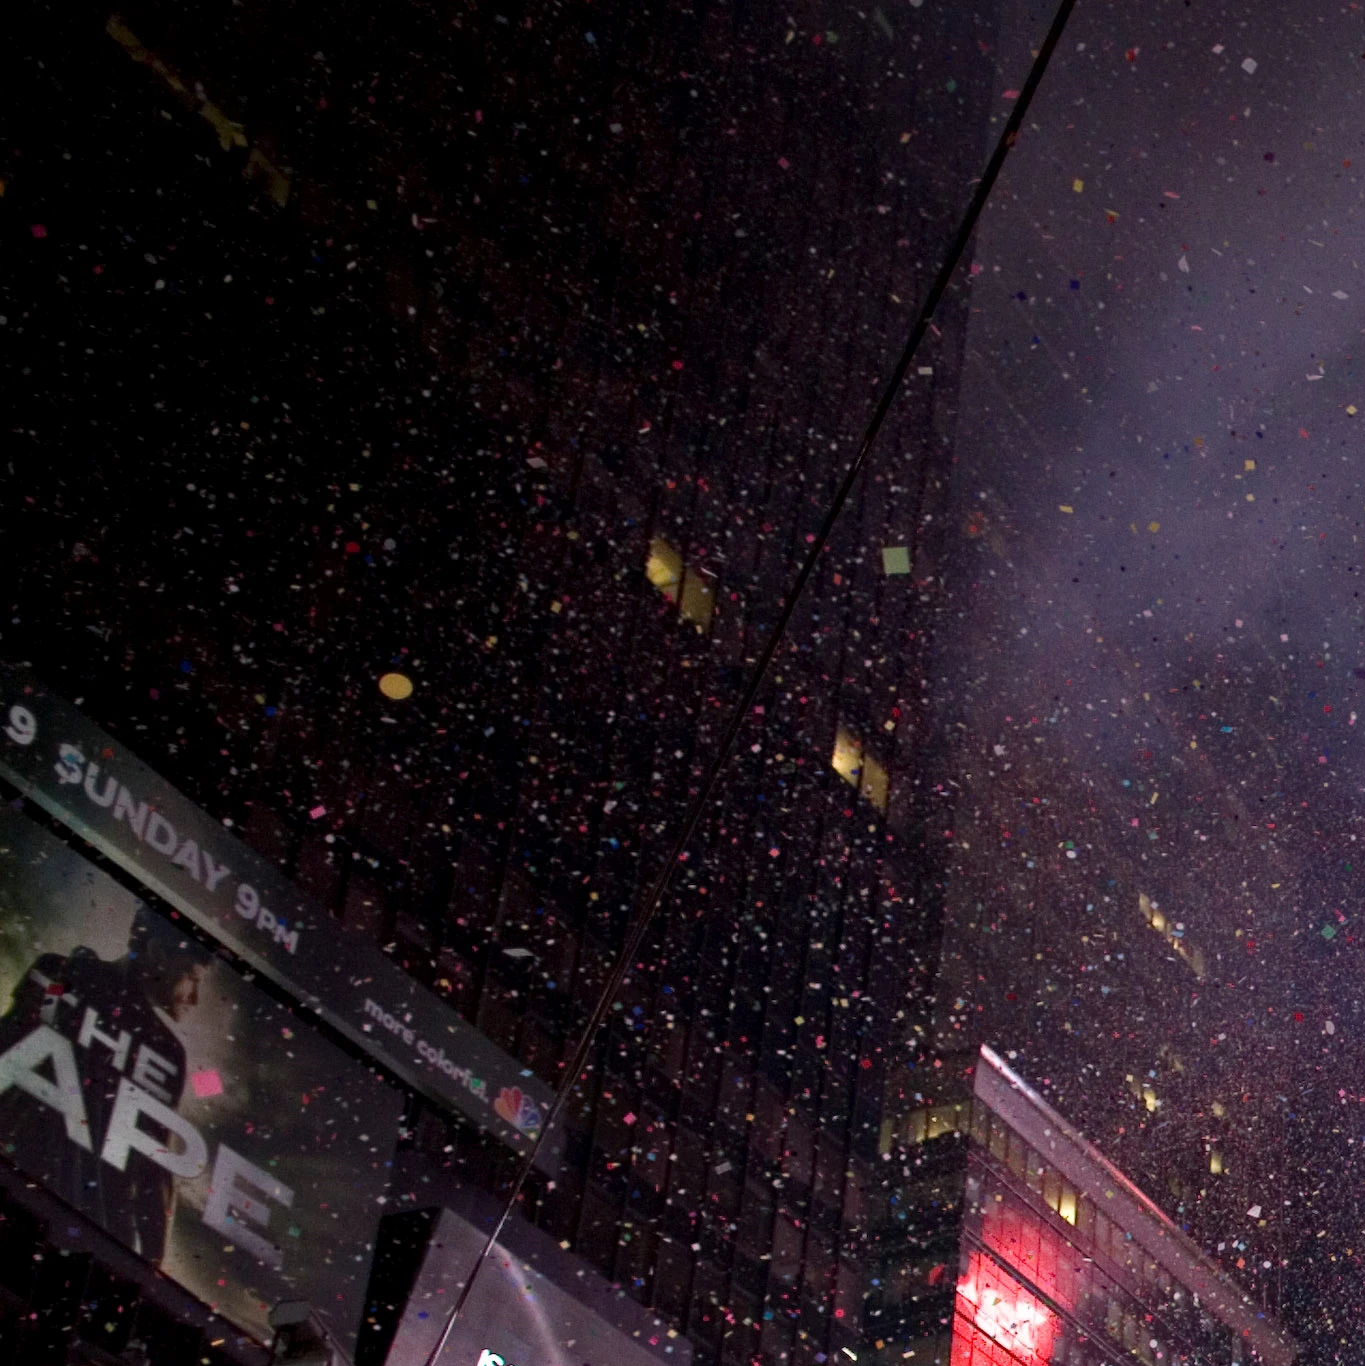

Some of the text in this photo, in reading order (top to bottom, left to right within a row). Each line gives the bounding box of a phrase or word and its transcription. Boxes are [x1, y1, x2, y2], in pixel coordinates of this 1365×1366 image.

[3, 704, 299, 956] 9 SUNDAY 9PM
[28, 968, 180, 1104] THE
